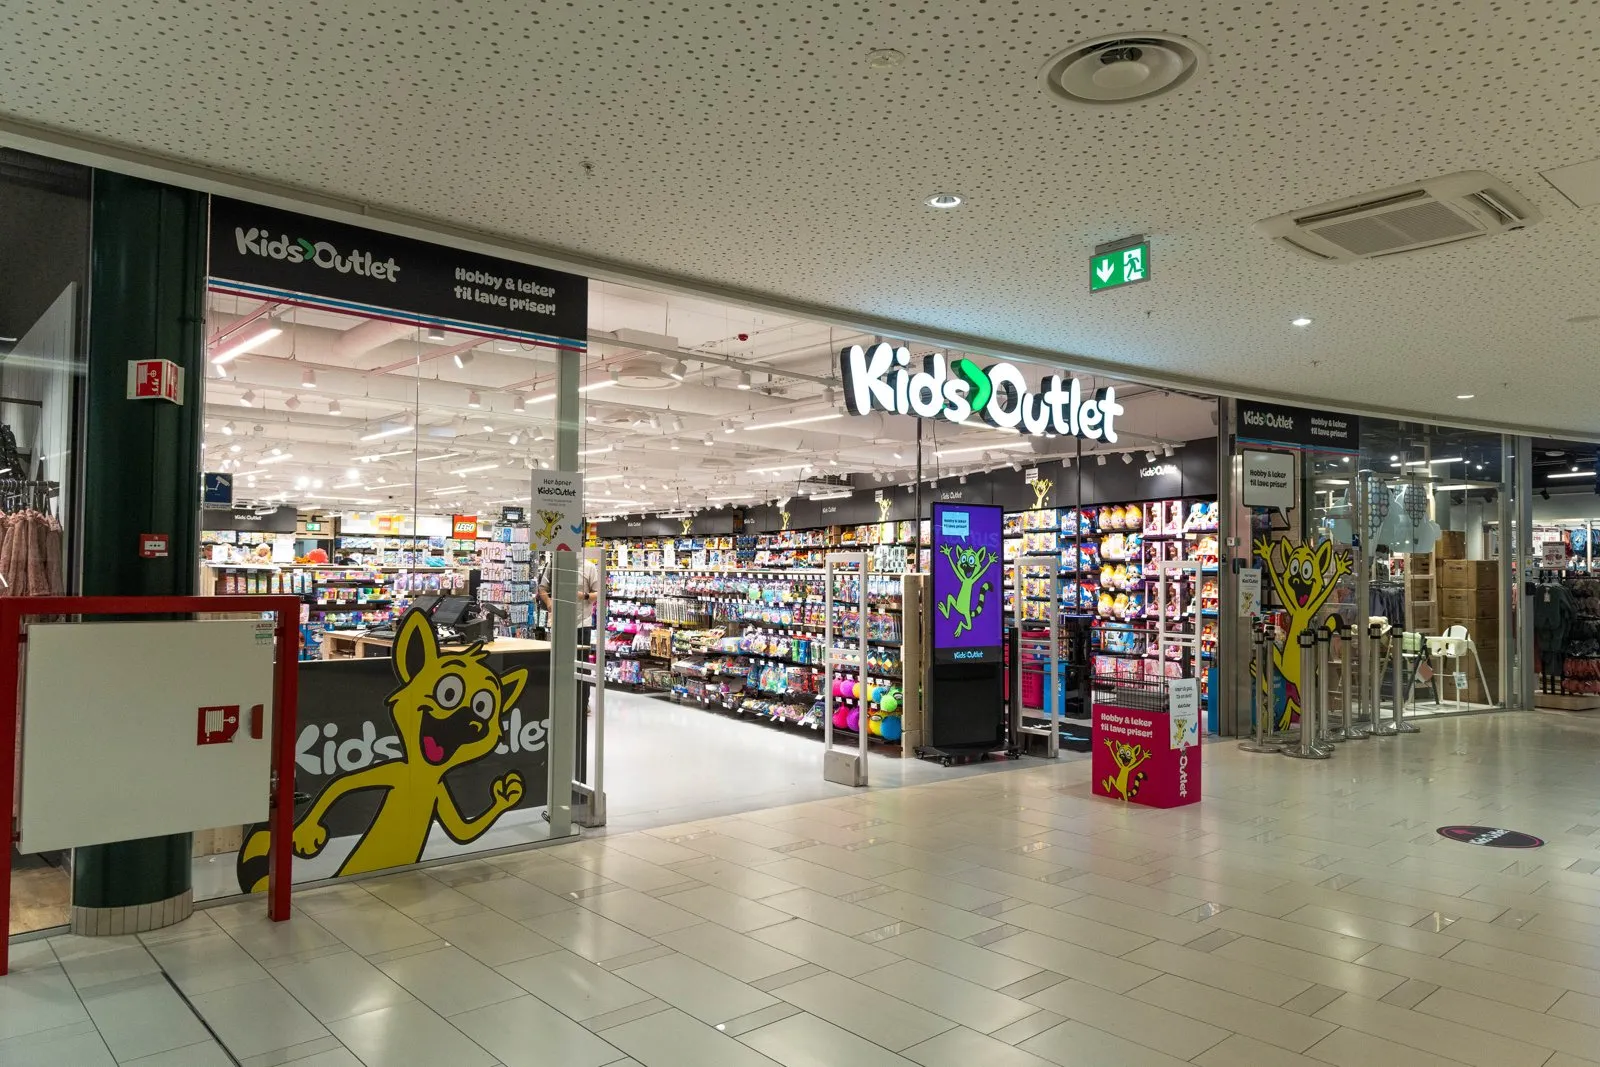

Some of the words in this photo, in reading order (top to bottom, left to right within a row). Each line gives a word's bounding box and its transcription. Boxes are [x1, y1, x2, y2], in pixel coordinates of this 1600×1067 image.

[235, 227, 304, 264] Kids
[312, 241, 400, 283] Outlet
[455, 267, 503, 290] Hobby
[505, 278, 516, 291] &
[517, 278, 556, 298] leker
[454, 285, 473, 301] til
[474, 289, 508, 307] lave
[509, 297, 556, 316] priser!
[845, 342, 971, 423] Kids
[986, 362, 1124, 444] Outlet
[1243, 410, 1264, 426] Kids
[1266, 412, 1294, 430] Outlet
[1311, 417, 1328, 428] Hobby
[1332, 419, 1347, 429] leker
[1317, 428, 1330, 436] lave
[1249, 469, 1267, 479] Hobby
[1271, 470, 1287, 479] leker
[537, 486, 553, 495] Kids
[554, 487, 577, 497] Outlet
[1257, 479, 1269, 488] lave
[455, 523, 475, 532] LEGO
[1100, 712, 1124, 725] Hobby
[1124, 716, 1130, 724] &
[1130, 716, 1153, 728] leker
[1100, 723, 1109, 731] til
[1109, 724, 1126, 734] lave
[1126, 728, 1153, 739] priser!
[1179, 755, 1188, 798] Outlet
